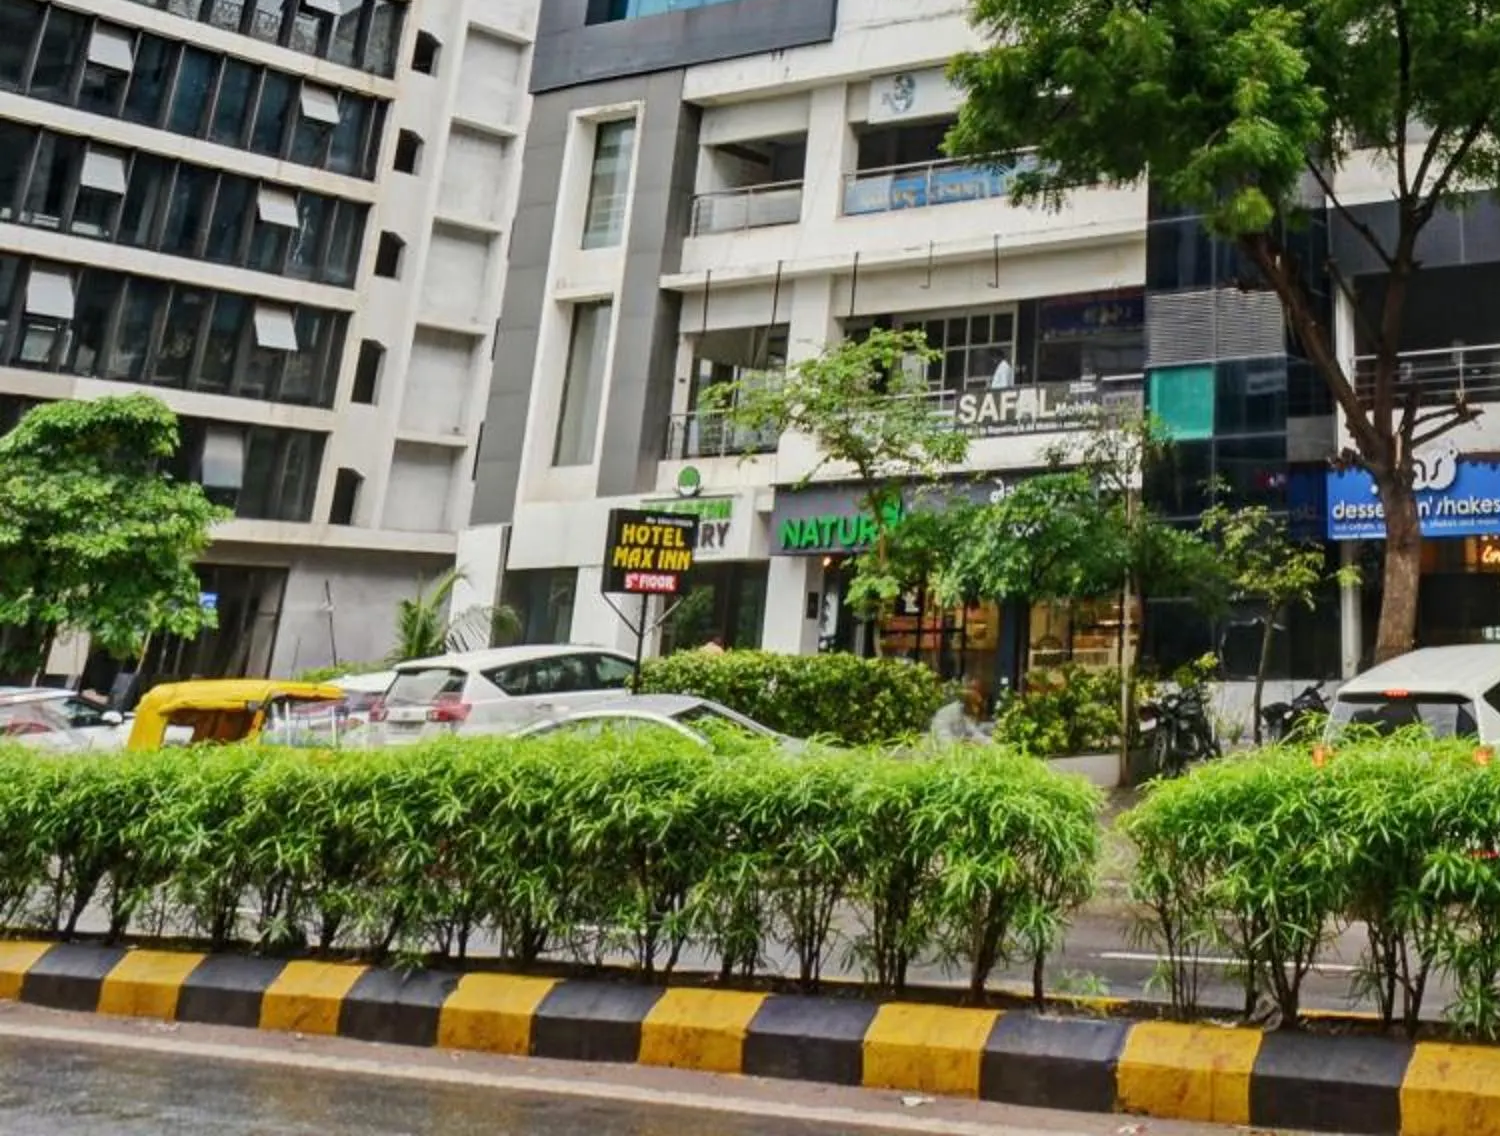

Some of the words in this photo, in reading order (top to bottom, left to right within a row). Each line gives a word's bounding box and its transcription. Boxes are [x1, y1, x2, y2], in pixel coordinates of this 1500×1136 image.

[621, 523, 686, 548] HOTEL
[612, 546, 655, 570] MAX
[656, 548, 692, 571] INN
